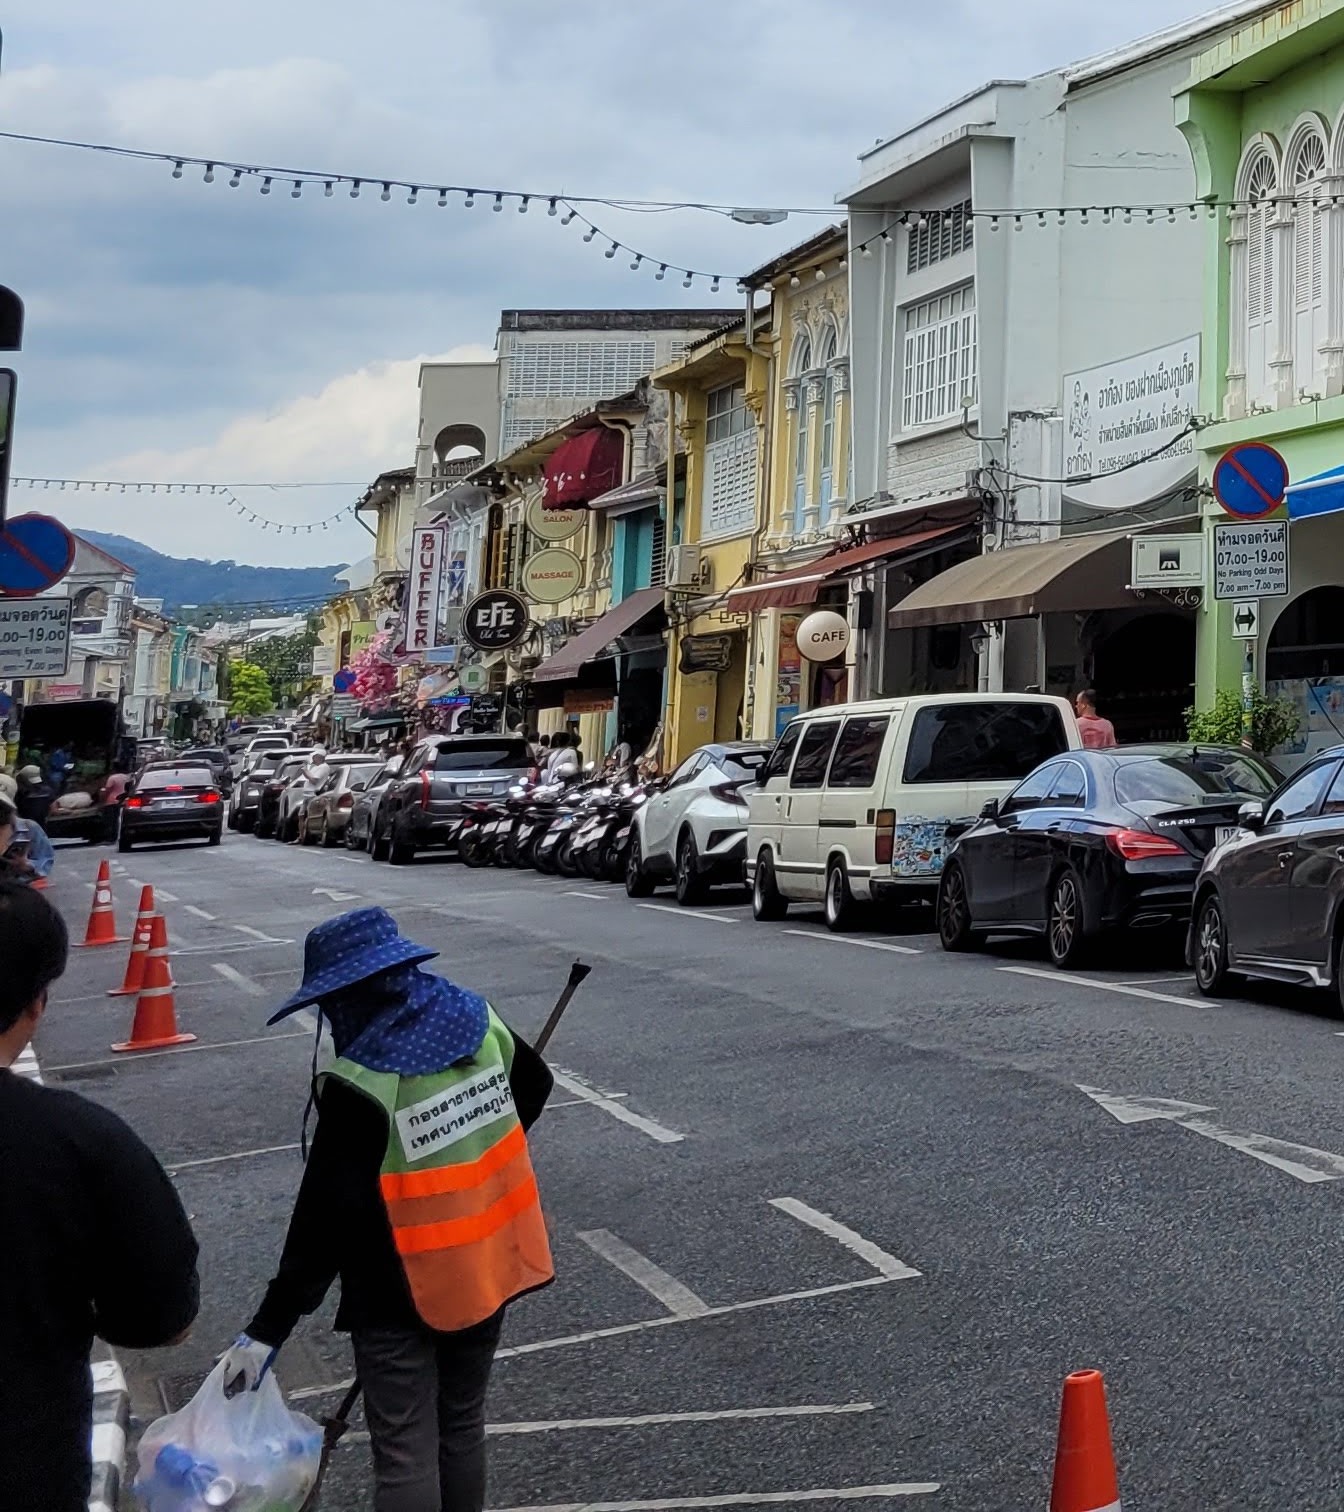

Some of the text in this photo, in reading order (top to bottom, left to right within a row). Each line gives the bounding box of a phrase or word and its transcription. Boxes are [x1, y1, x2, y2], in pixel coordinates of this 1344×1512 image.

[543, 515, 573, 523] SALON
[1218, 524, 1285, 546] ห้ามจอดวันคี่
[530, 570, 574, 580] MASSAGE
[1229, 569, 1252, 577] Parking
[1269, 567, 1284, 575] Days
[414, 533, 435, 647] BUFFER
[1218, 582, 1235, 593] 7.00
[475, 601, 516, 629] EFE
[408, 1072, 506, 1128] กองสาธารณสุข
[411, 1086, 513, 1149] เทศบาลนครภูเก็
